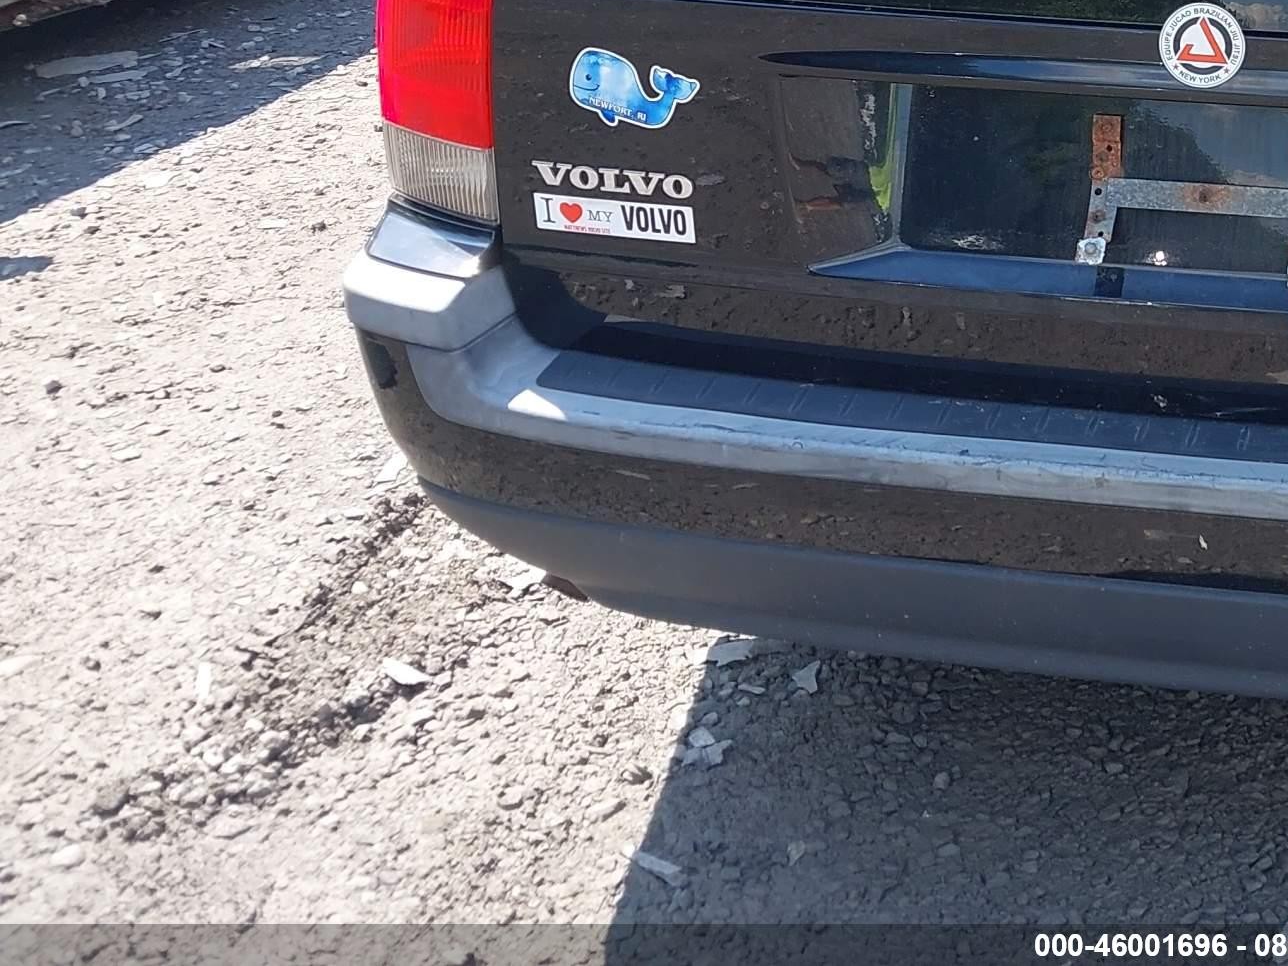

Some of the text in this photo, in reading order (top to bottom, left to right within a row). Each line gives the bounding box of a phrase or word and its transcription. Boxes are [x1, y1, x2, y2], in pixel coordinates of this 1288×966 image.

[1193, 7, 1233, 30] BRAZILIAN
[1229, 27, 1240, 41] JIU
[1164, 31, 1174, 61] EQUIPE
[1230, 43, 1241, 66] JITSU
[1178, 69, 1222, 84] NEW YORK
[637, 111, 647, 121] RI
[531, 160, 693, 199] VOLVO
[540, 196, 687, 236] I MY VOLVO
